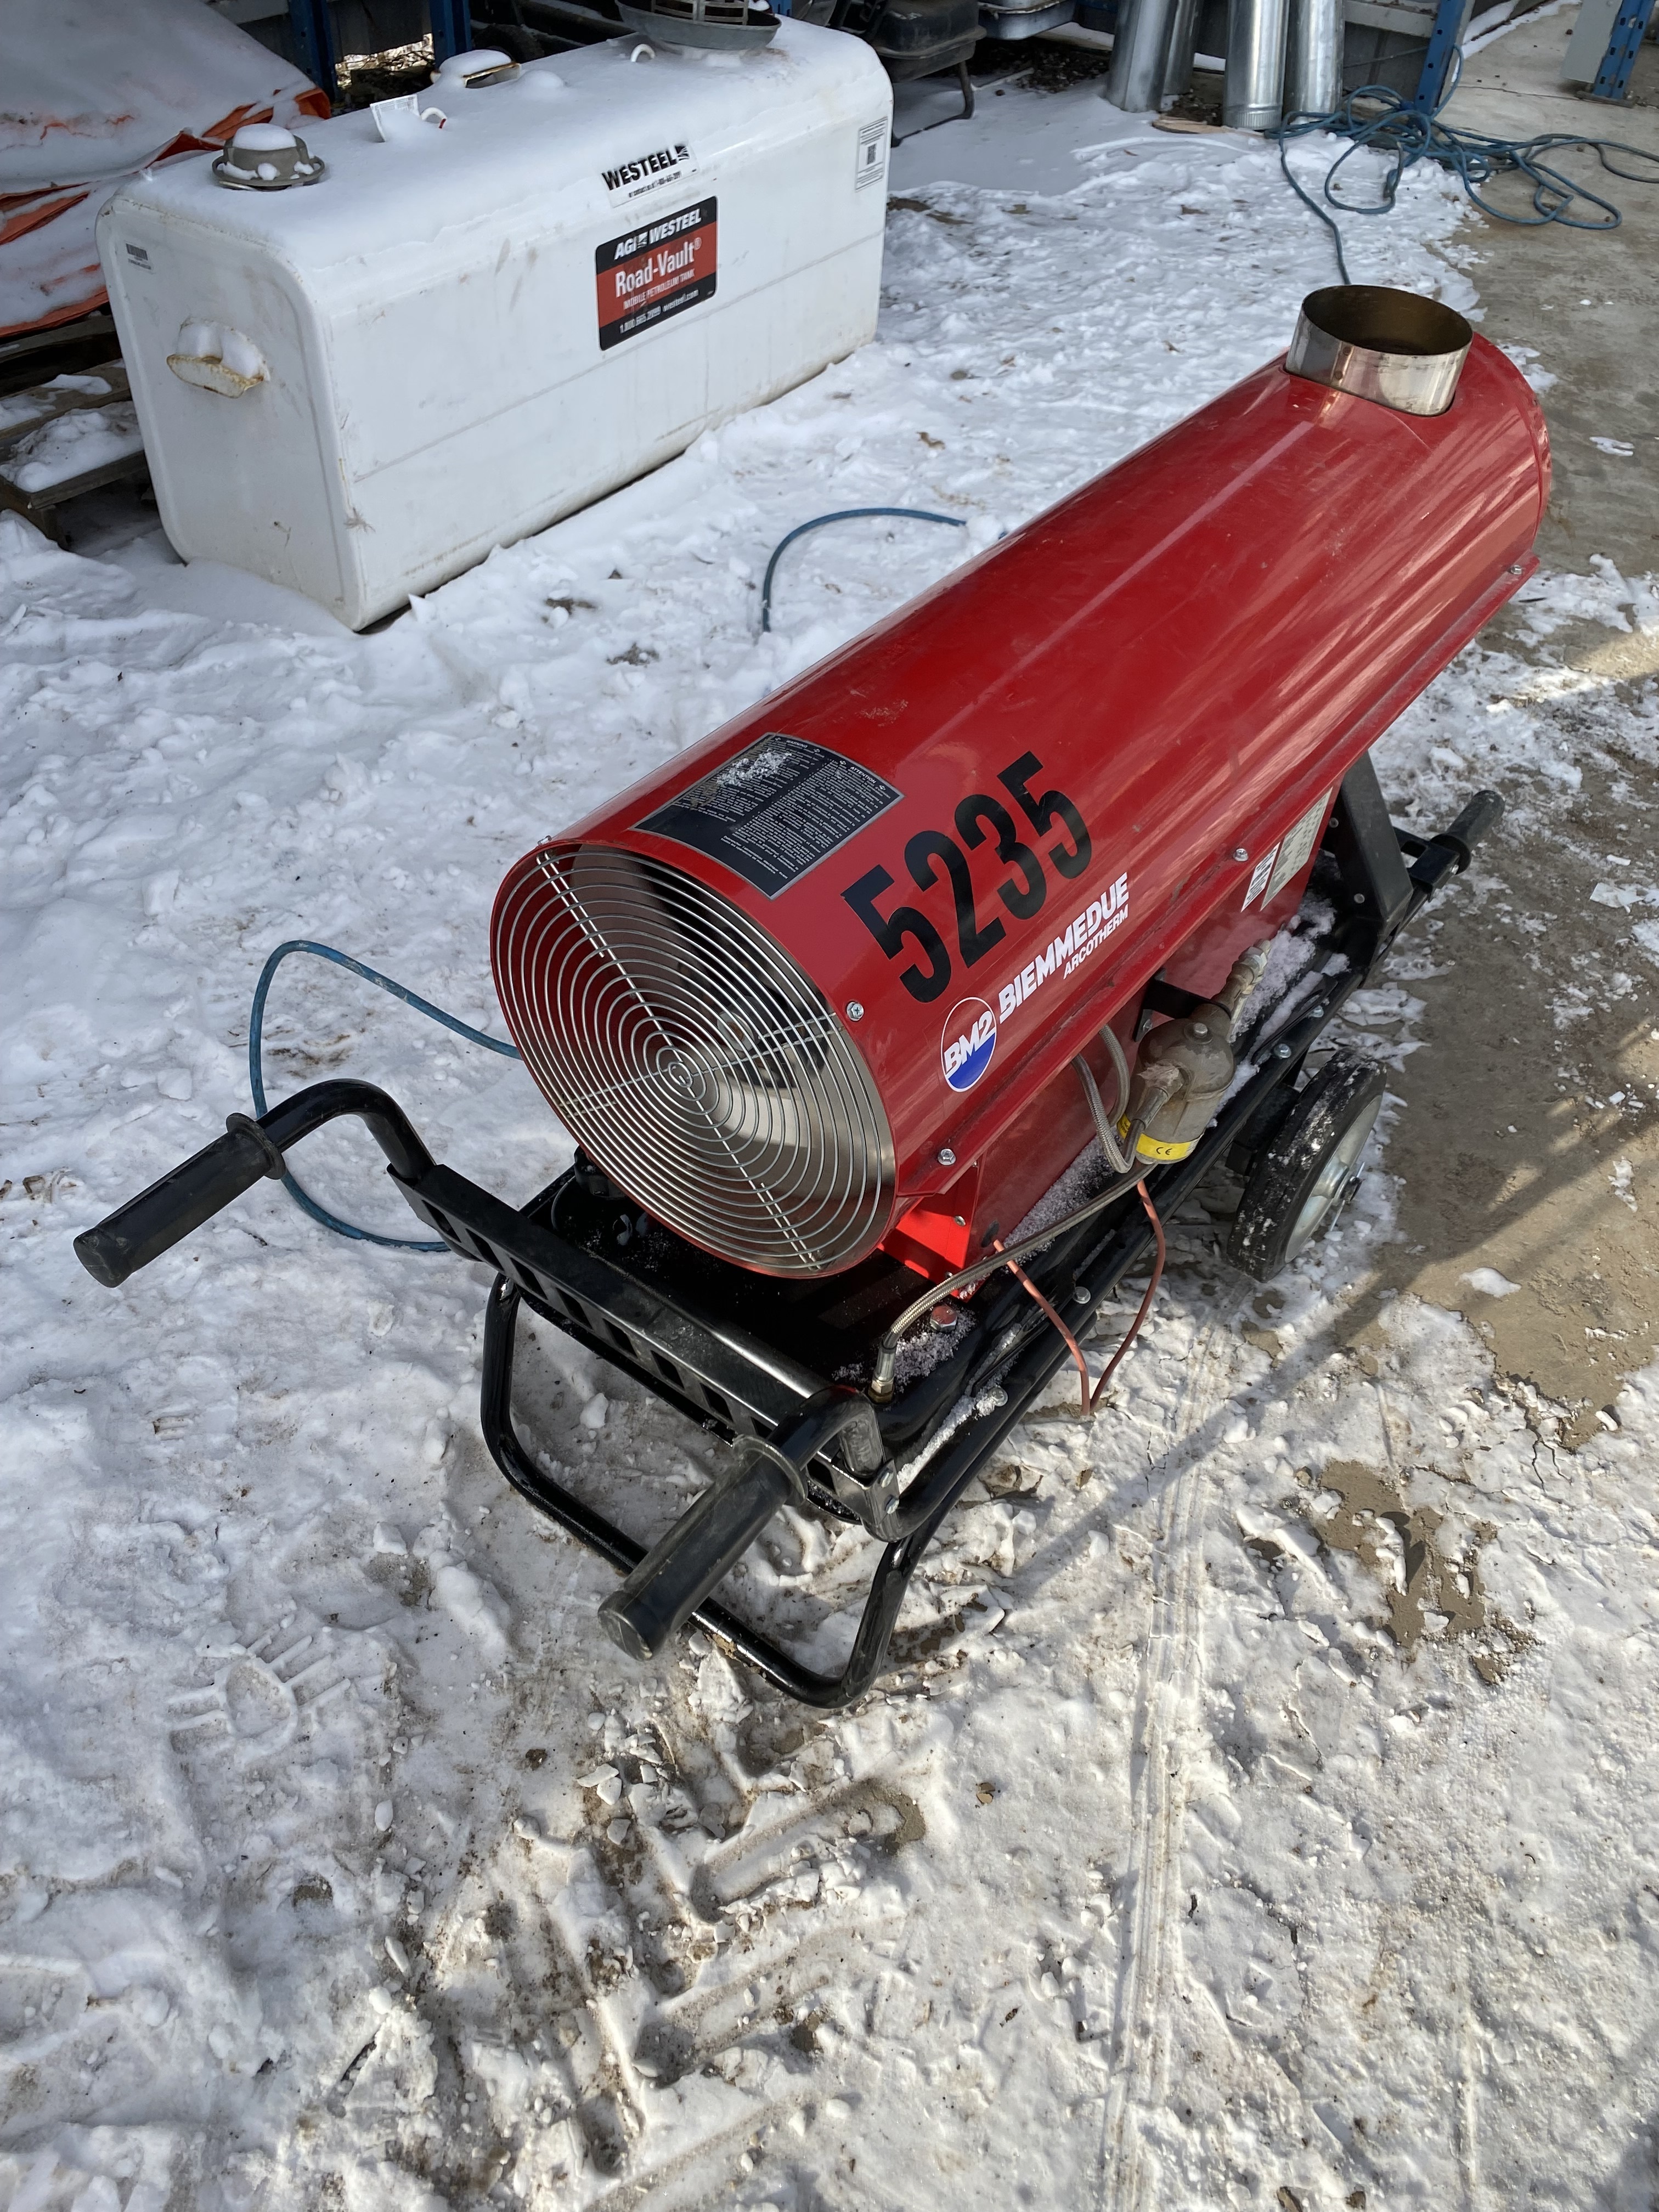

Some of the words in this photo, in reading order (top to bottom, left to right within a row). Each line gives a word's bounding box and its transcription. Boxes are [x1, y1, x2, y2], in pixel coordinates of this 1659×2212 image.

[602, 148, 678, 190] WESTEEL
[614, 236, 637, 261] AGI
[649, 208, 702, 244] WESTEEL
[850, 766, 877, 785] ATTENTION
[840, 751, 1092, 1003] 5235
[999, 871, 1130, 1024] BIEMMEDUE
[1063, 904, 1128, 980] ARCOTHERM
[943, 1011, 996, 1077] BM2
